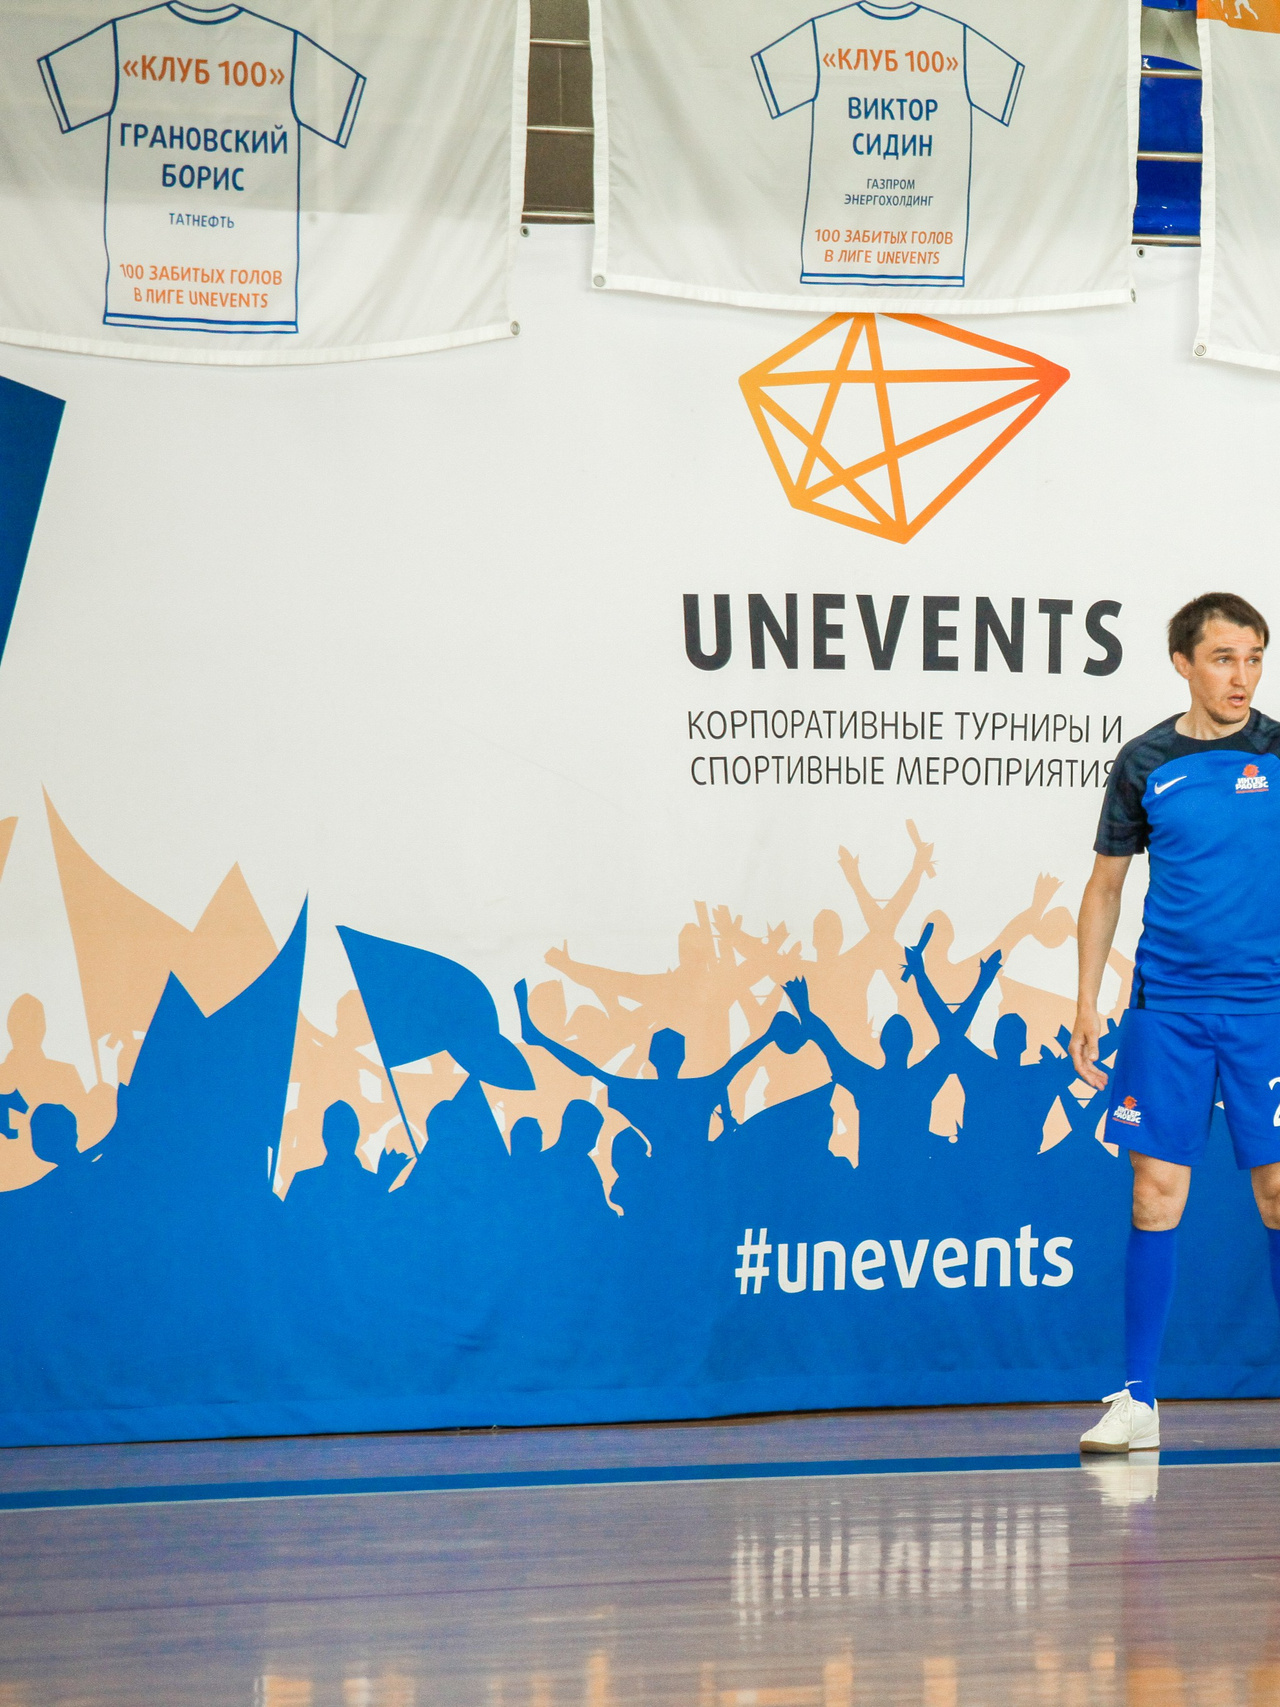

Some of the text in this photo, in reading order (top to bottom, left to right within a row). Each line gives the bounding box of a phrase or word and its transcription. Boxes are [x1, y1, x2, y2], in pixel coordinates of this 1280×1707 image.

[122, 54, 285, 88] «КЛУБ 100»
[822, 47, 959, 73] «КЛУБ 100»
[848, 96, 939, 122] ВИКТОР
[120, 122, 288, 154] ГРАНОВСКИЙ
[852, 132, 933, 161] СИДИН
[161, 163, 245, 192] БОРИС
[866, 178, 915, 190] ГАЗПРОМ
[844, 193, 934, 208] ЭНЕРГОХОЛДИНГ
[168, 212, 235, 229] ТАТНЕФТЬ
[815, 228, 954, 245] 100 ЗАБИТЫХ ГОЛОВ
[824, 249, 940, 265] В ЛИГЕ UNEVENTS
[119, 263, 283, 286] 100 ЗАБИТЫХ ГОЛОВ
[133, 286, 268, 309] В ЛИГЕ UNEVENTS
[682, 592, 1123, 677] UNEVENTS
[687, 709, 1123, 744] КОРПОРАТИВНЫЕ ТУРНИРЫ И
[691, 755, 885, 786] СПОРТИВНЫЕ
[734, 1223, 1074, 1295] #unevents
